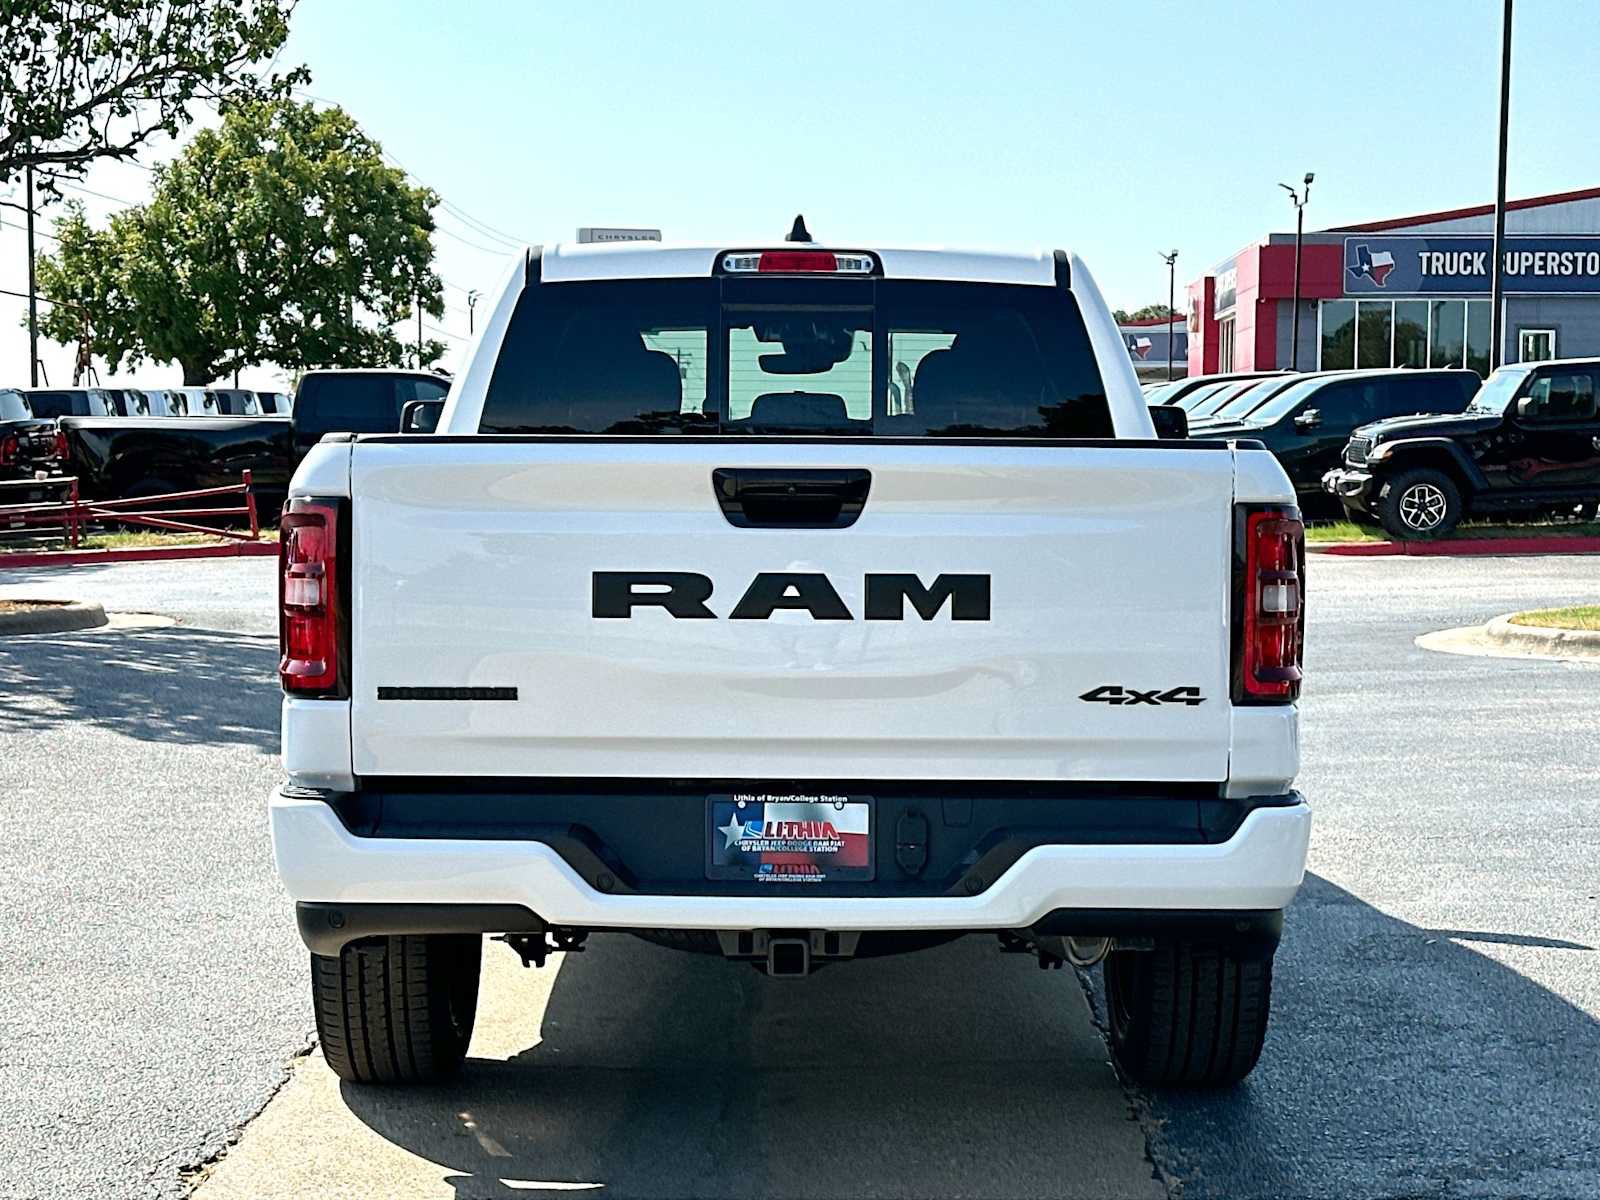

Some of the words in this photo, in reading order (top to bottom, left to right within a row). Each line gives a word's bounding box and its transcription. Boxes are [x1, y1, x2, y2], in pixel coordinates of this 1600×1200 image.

[1418, 251, 1487, 275] TRUCK
[1502, 252, 1600, 275] UPERSTO
[592, 571, 991, 621] RAM
[1078, 686, 1207, 705] 4x4
[762, 820, 840, 839] LITHIA
